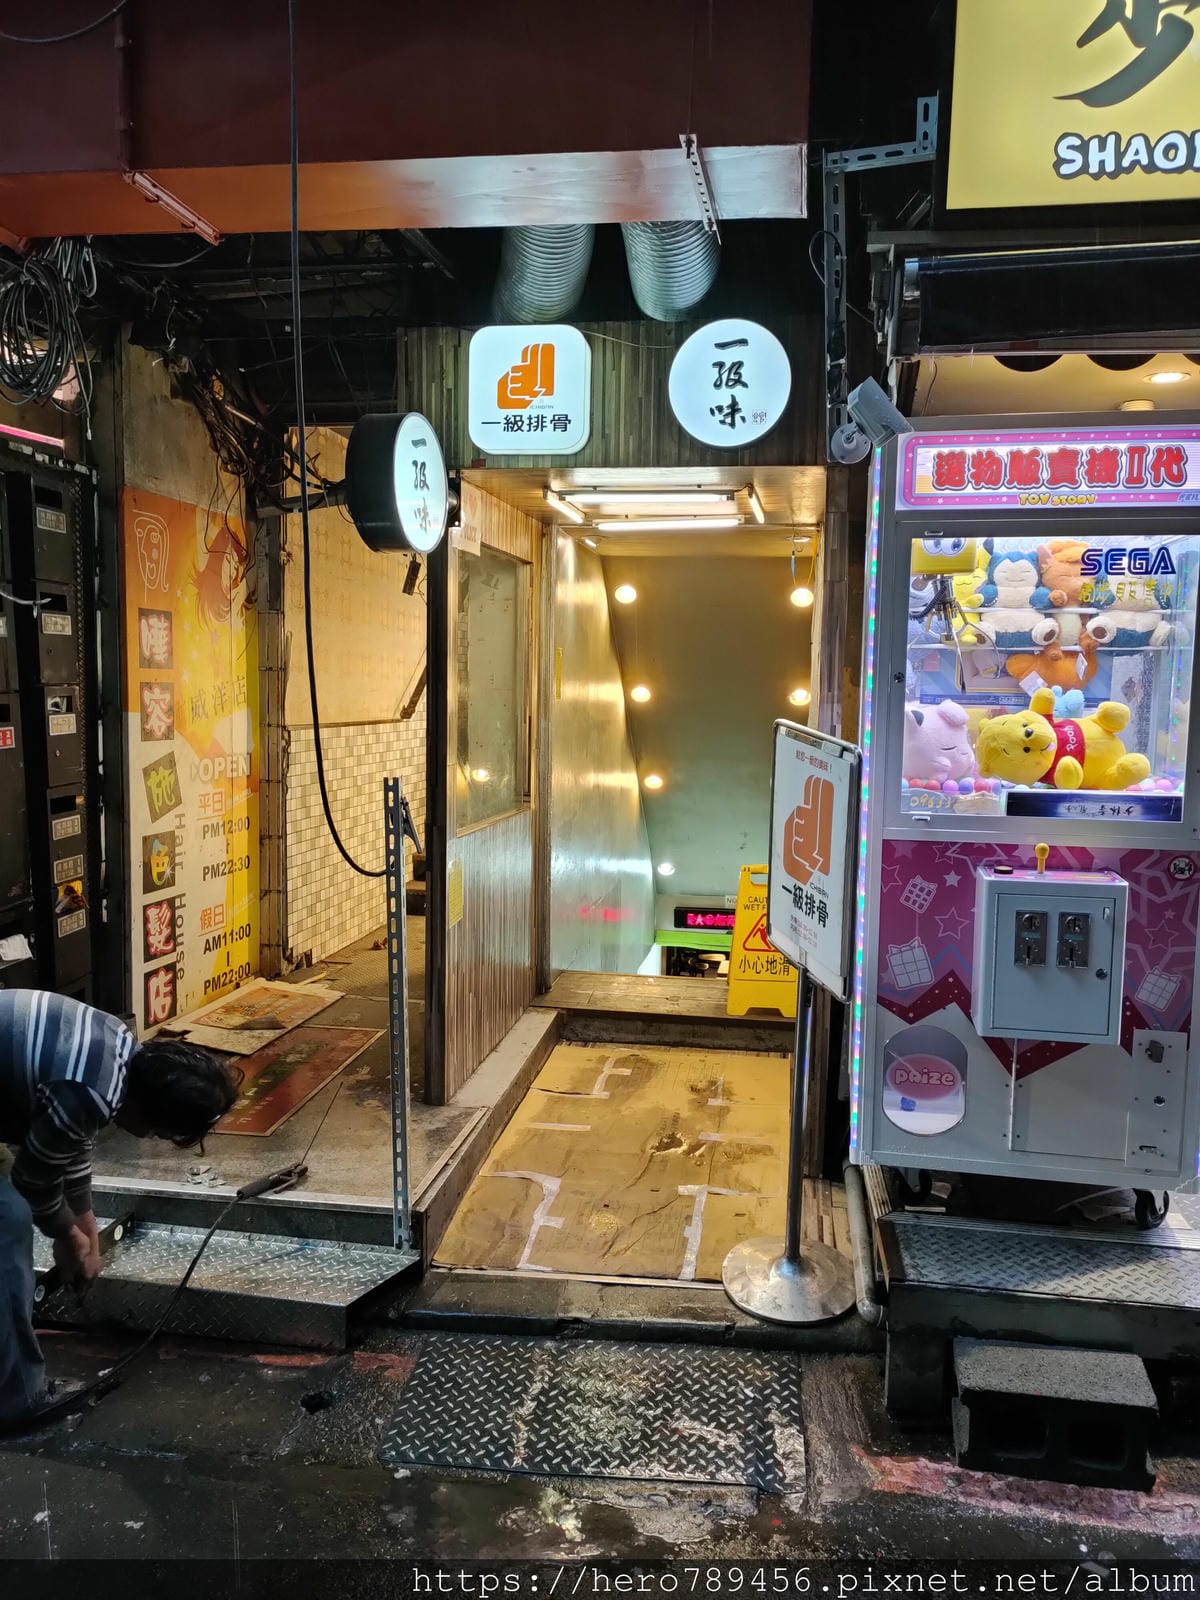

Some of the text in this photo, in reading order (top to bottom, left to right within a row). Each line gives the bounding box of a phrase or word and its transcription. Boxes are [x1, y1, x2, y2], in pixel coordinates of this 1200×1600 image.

[481, 414, 571, 432] 一級排骨
[1018, 493, 1097, 507] TOY STORY
[1080, 547, 1177, 576] SEGA
[1064, 725, 1078, 752] Pooh
[199, 754, 251, 781] OPEN
[198, 789, 225, 815] 平日
[202, 816, 250, 840] PM12:00
[174, 813, 186, 871] Hair
[202, 855, 250, 881] PM22:30
[200, 904, 225, 930] 假日
[781, 882, 829, 928] 一級排骨
[175, 892, 187, 981] House
[203, 923, 251, 954] AM11:00
[203, 962, 251, 995] PM22:00
